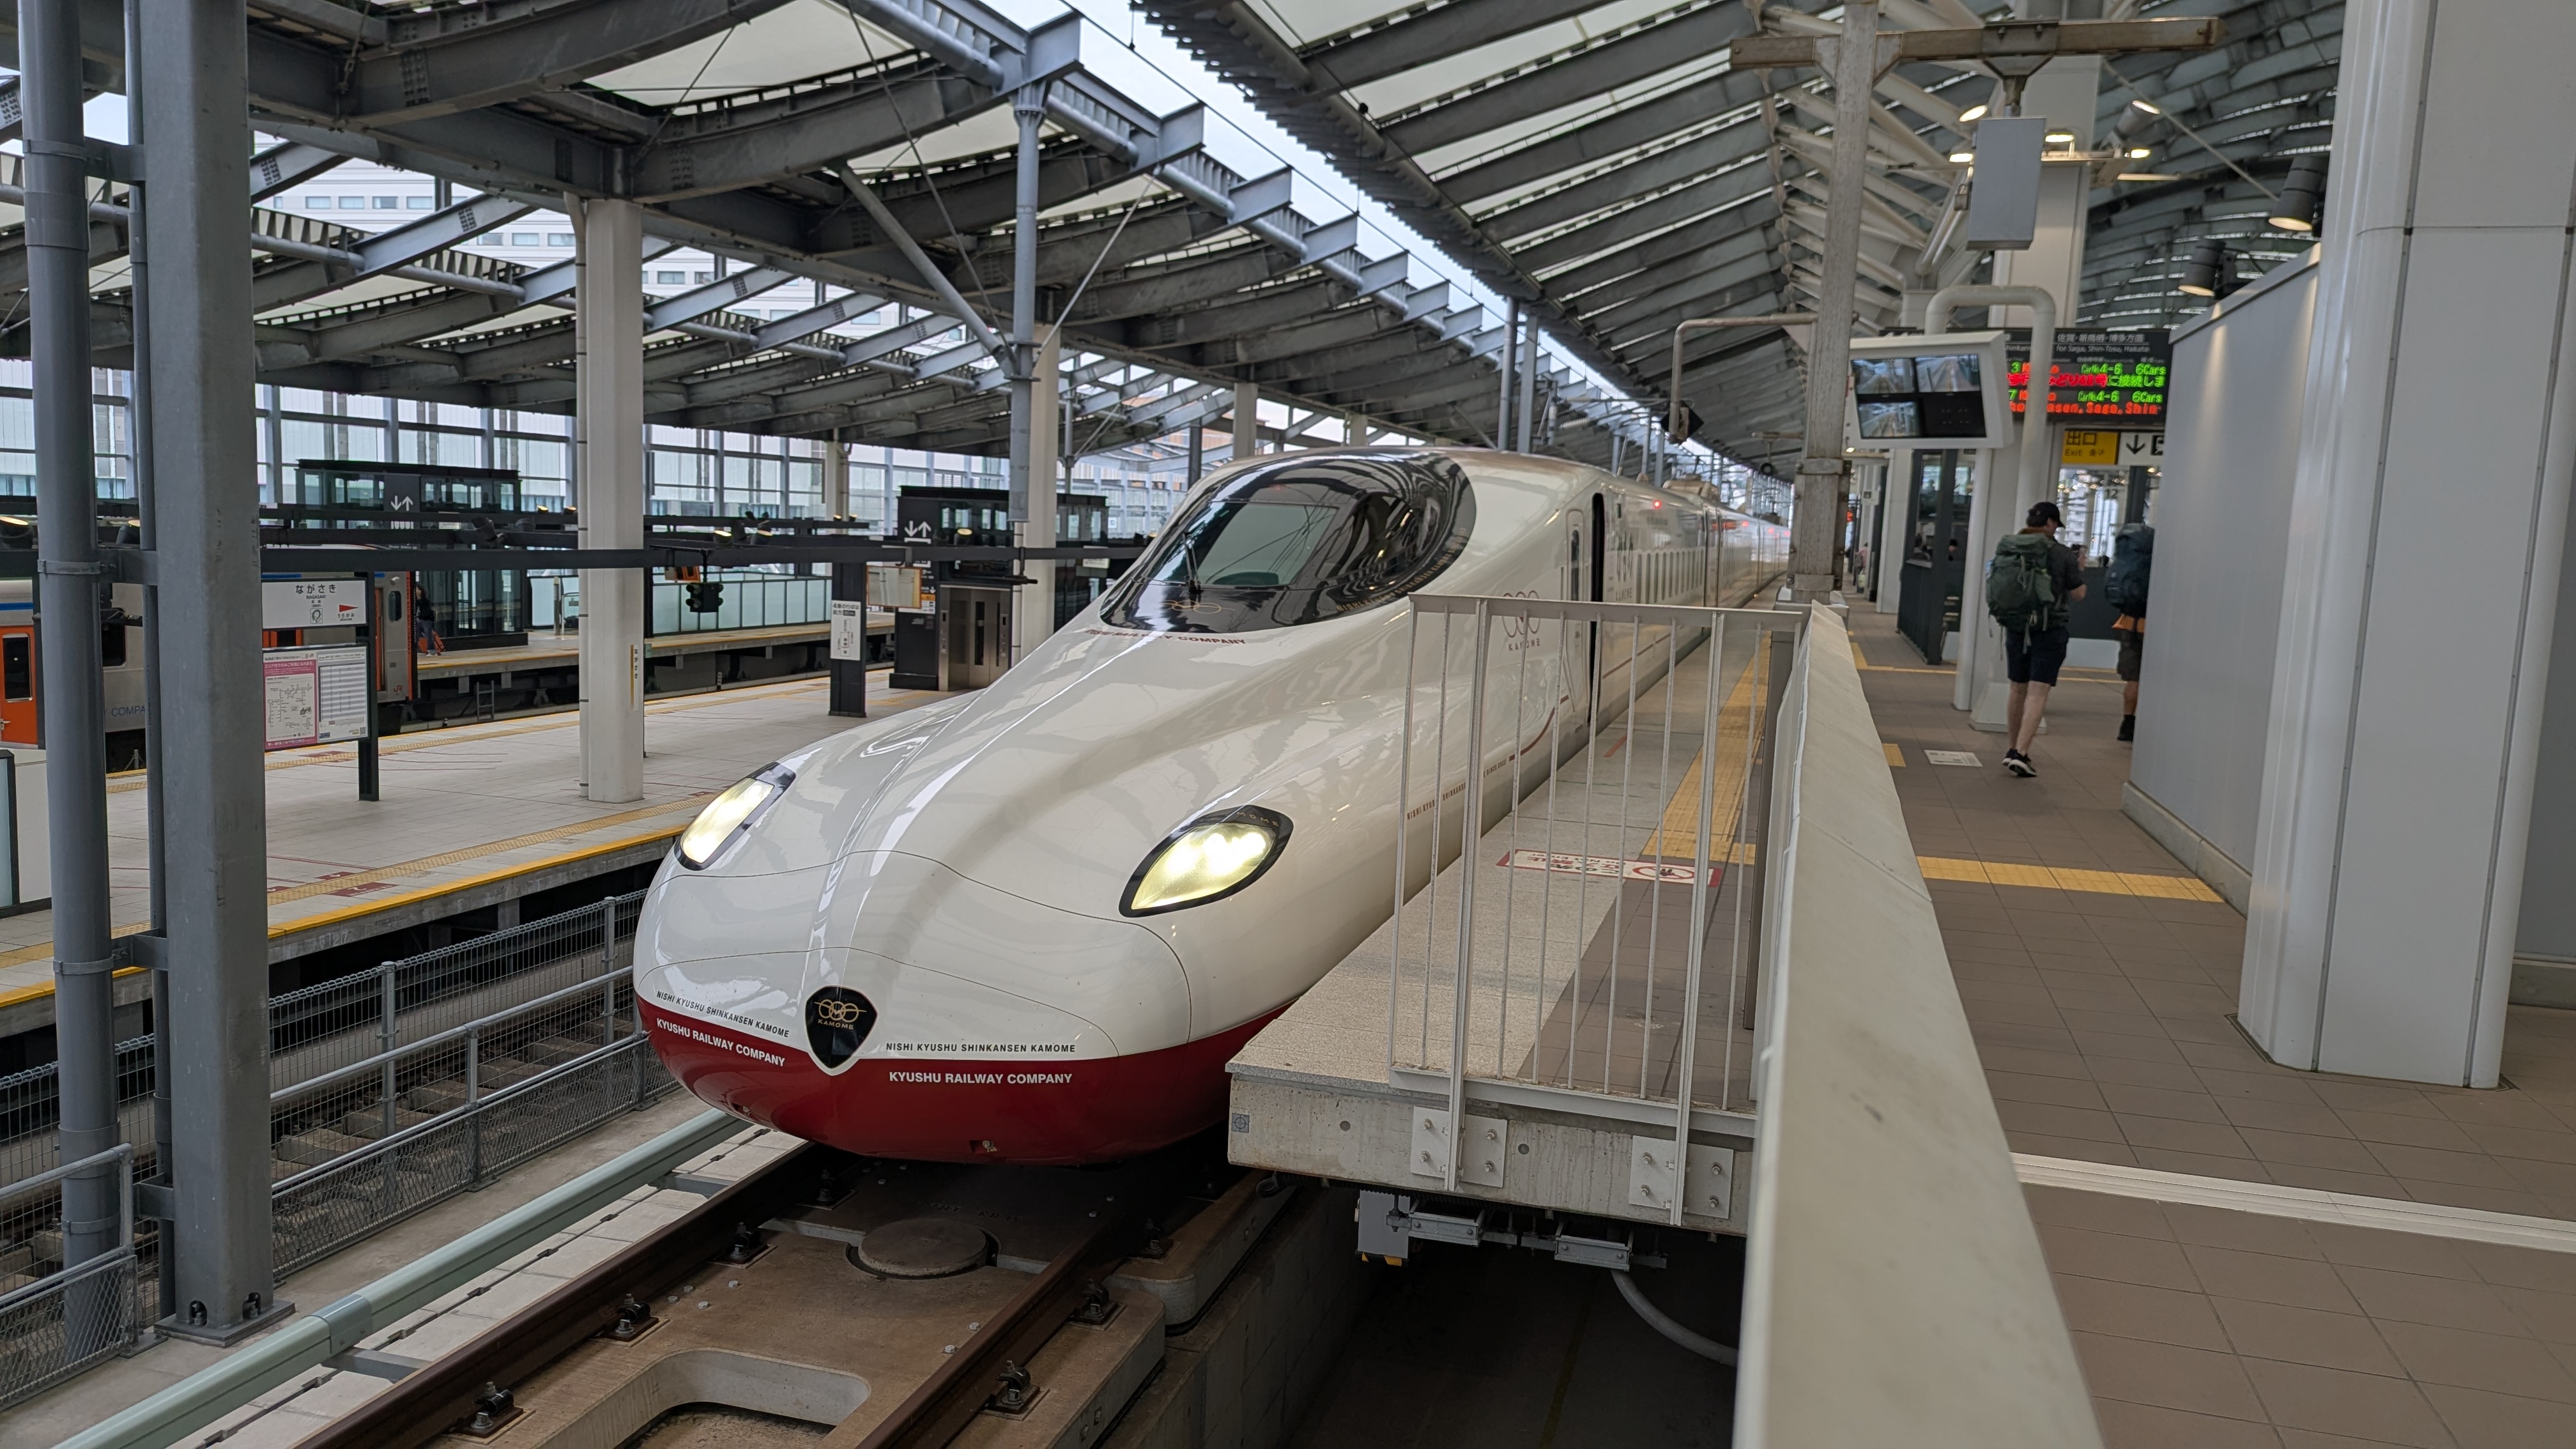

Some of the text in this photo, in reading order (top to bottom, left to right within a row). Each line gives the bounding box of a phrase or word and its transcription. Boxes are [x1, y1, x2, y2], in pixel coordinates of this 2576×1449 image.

[2011, 362, 2021, 373] 3
[2008, 388, 2018, 400] 7
[2066, 431, 2097, 445] 出口
[296, 584, 336, 594] ながさき
[1178, 636, 1246, 645] COMPANY
[111, 705, 145, 716] COMPA
[1407, 782, 1466, 820] NISHI KYUS SHINKANSE
[657, 990, 790, 1038] NISHI KYUSHU SHINKANSEN KAMOME
[818, 1018, 854, 1030] KAMOME
[657, 1017, 785, 1067] KYUSHU RAILWAY COMPANY
[886, 1043, 913, 1051] NISHI
[917, 1043, 957, 1052] KYUSHU
[961, 1044, 1027, 1052] SHINKANSEN
[889, 1071, 1073, 1084] KYUSHU RAILWAY COMPANY
